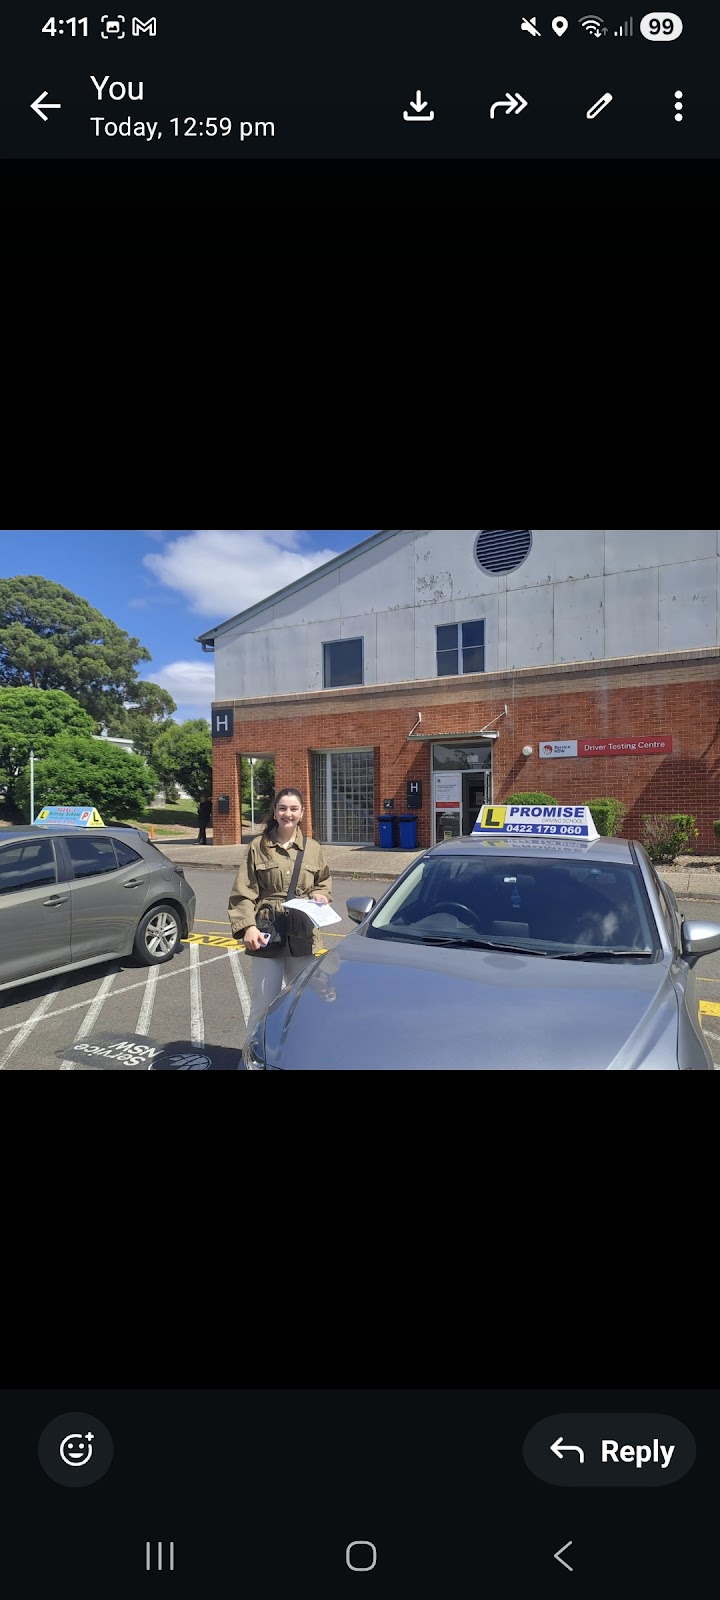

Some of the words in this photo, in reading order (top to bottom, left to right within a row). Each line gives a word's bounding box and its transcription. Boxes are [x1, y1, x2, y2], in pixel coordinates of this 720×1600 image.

[216, 714, 228, 732] H
[584, 744, 607, 752] Driver
[608, 742, 637, 751] Testing
[638, 741, 666, 749] Centre
[410, 782, 418, 793] H
[93, 812, 99, 822] L
[485, 809, 500, 827] L
[510, 807, 585, 818] PROMISE
[506, 824, 533, 833] 0422
[536, 825, 557, 834] 179
[560, 825, 582, 835] 060
[73, 1043, 146, 1066] Service
[108, 1041, 164, 1058] NSW
